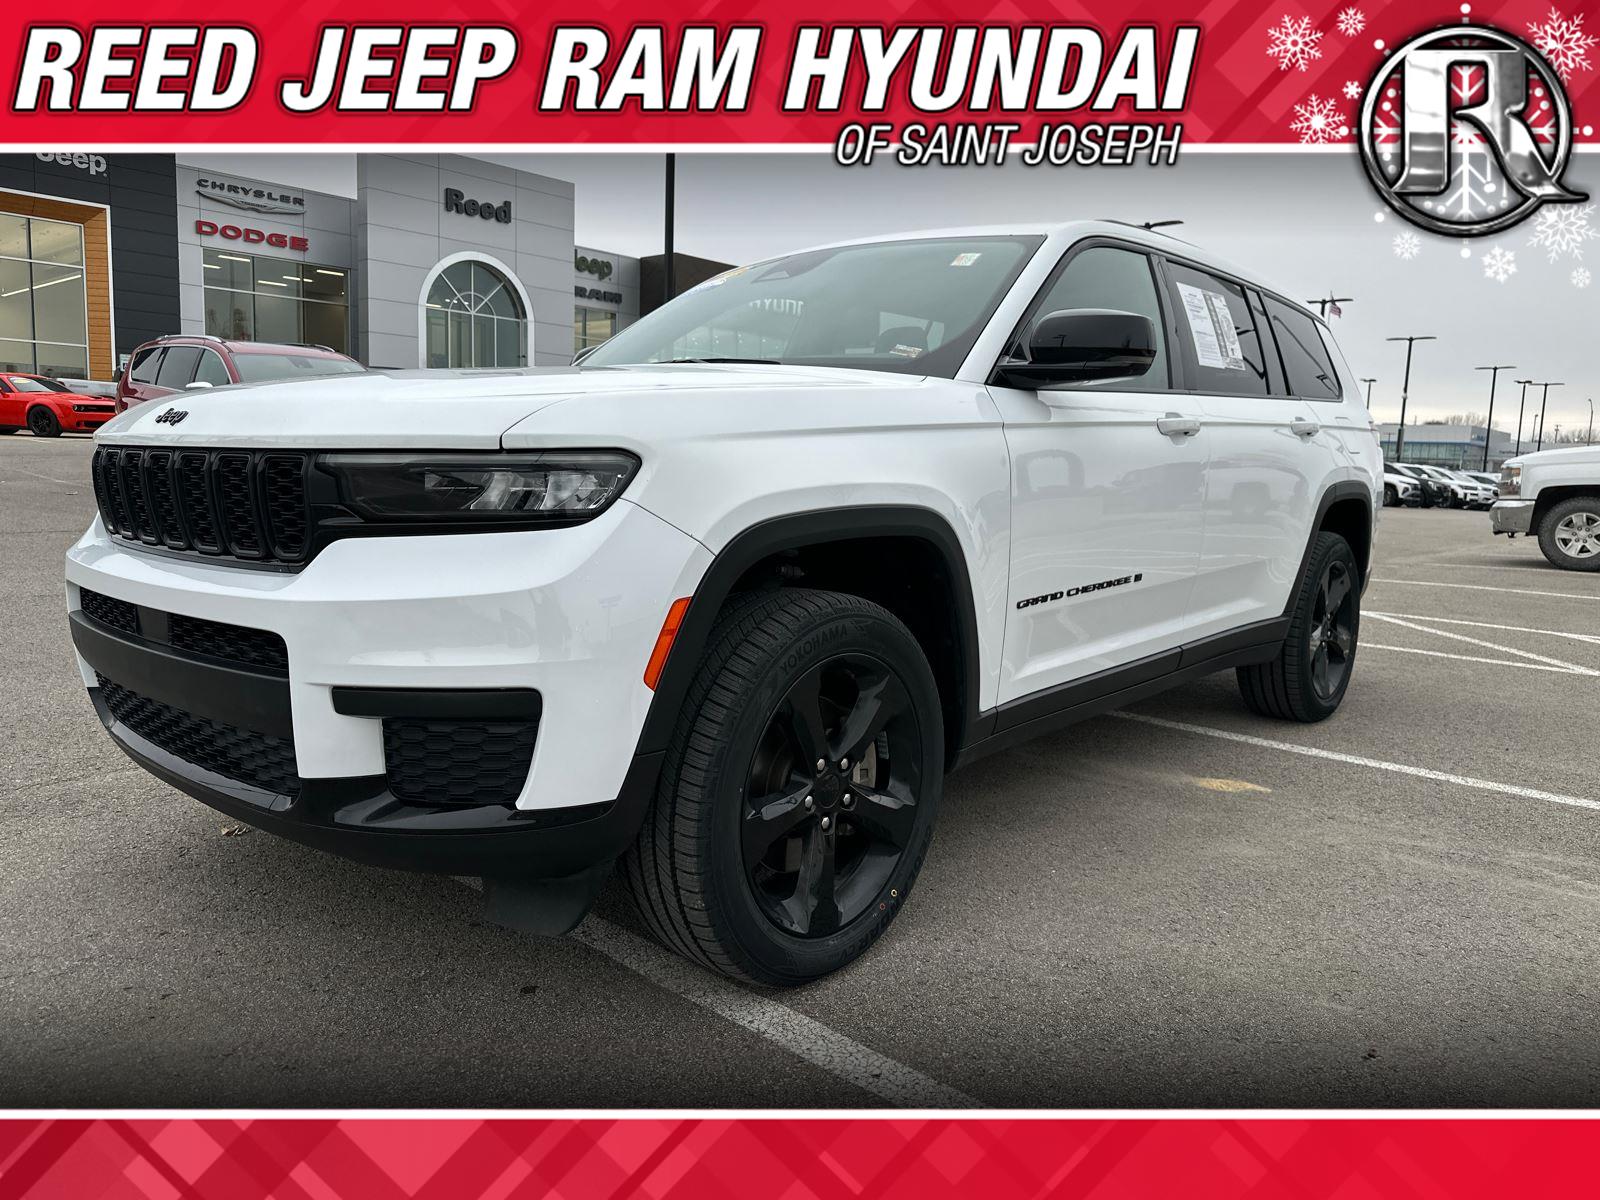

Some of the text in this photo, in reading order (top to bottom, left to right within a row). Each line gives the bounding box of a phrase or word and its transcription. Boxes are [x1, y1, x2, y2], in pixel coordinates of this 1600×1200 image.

[196, 178, 305, 206] CHRYSLER
[444, 187, 511, 224] Reed
[195, 219, 309, 251] DODGE
[574, 285, 622, 305] RAM
[155, 408, 189, 426] Jeep
[1016, 591, 1063, 609] GRAND
[1066, 576, 1132, 597] CHEROKEE
[780, 623, 848, 672] YOKOHAMA
